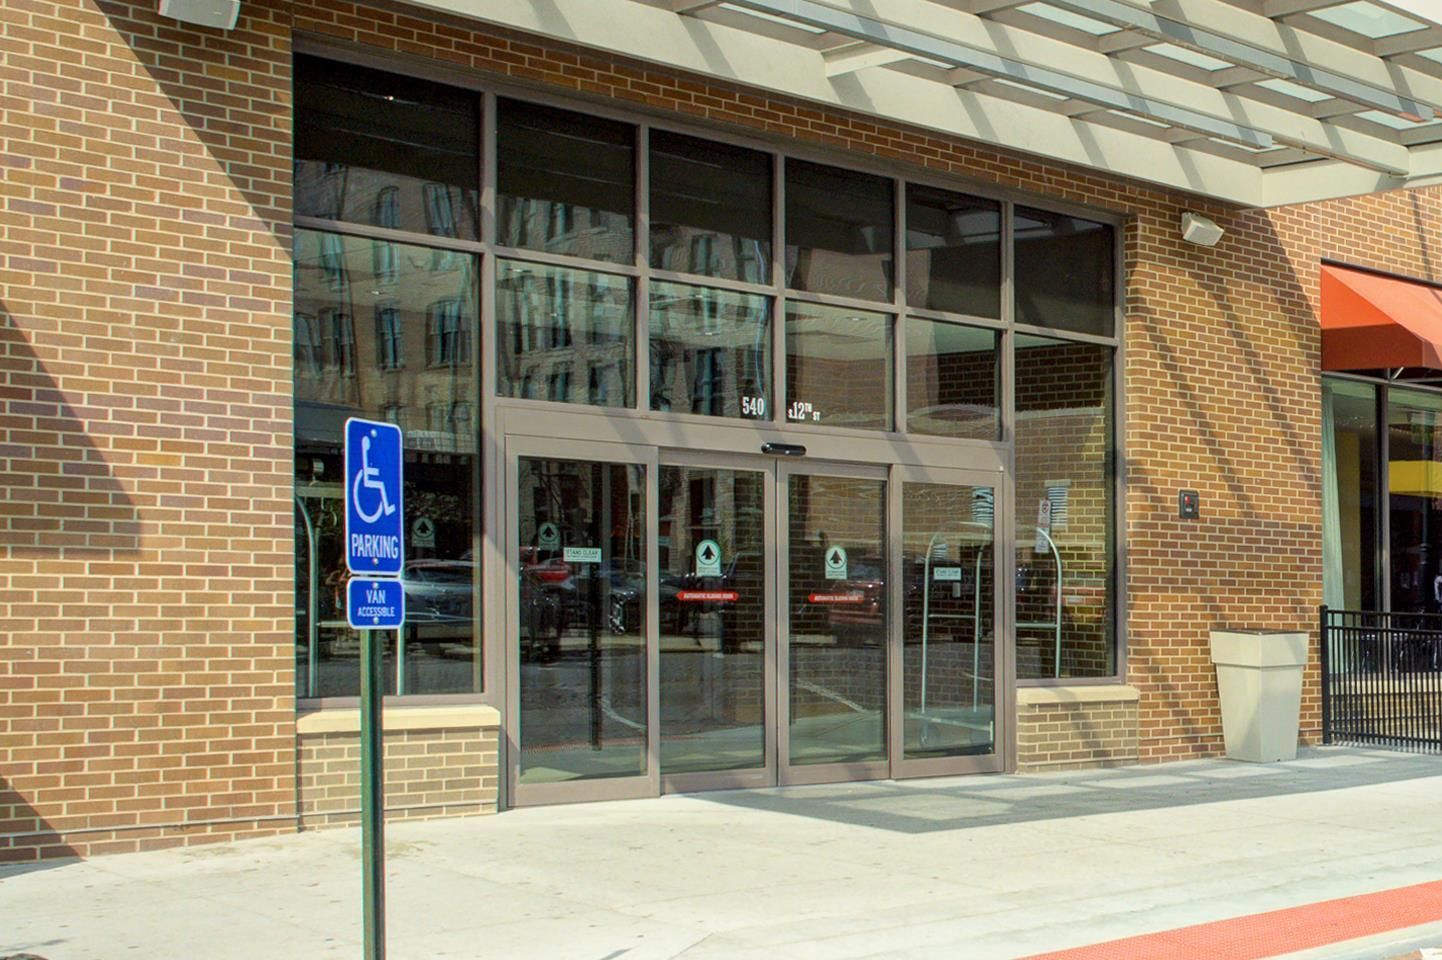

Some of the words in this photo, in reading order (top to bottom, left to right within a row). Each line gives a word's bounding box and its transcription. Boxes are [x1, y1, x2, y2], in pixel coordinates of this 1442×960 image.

[742, 396, 765, 416] 540
[351, 533, 399, 559] PARKING
[365, 589, 386, 604] VAN
[357, 606, 396, 617] ACCESSIBLE
